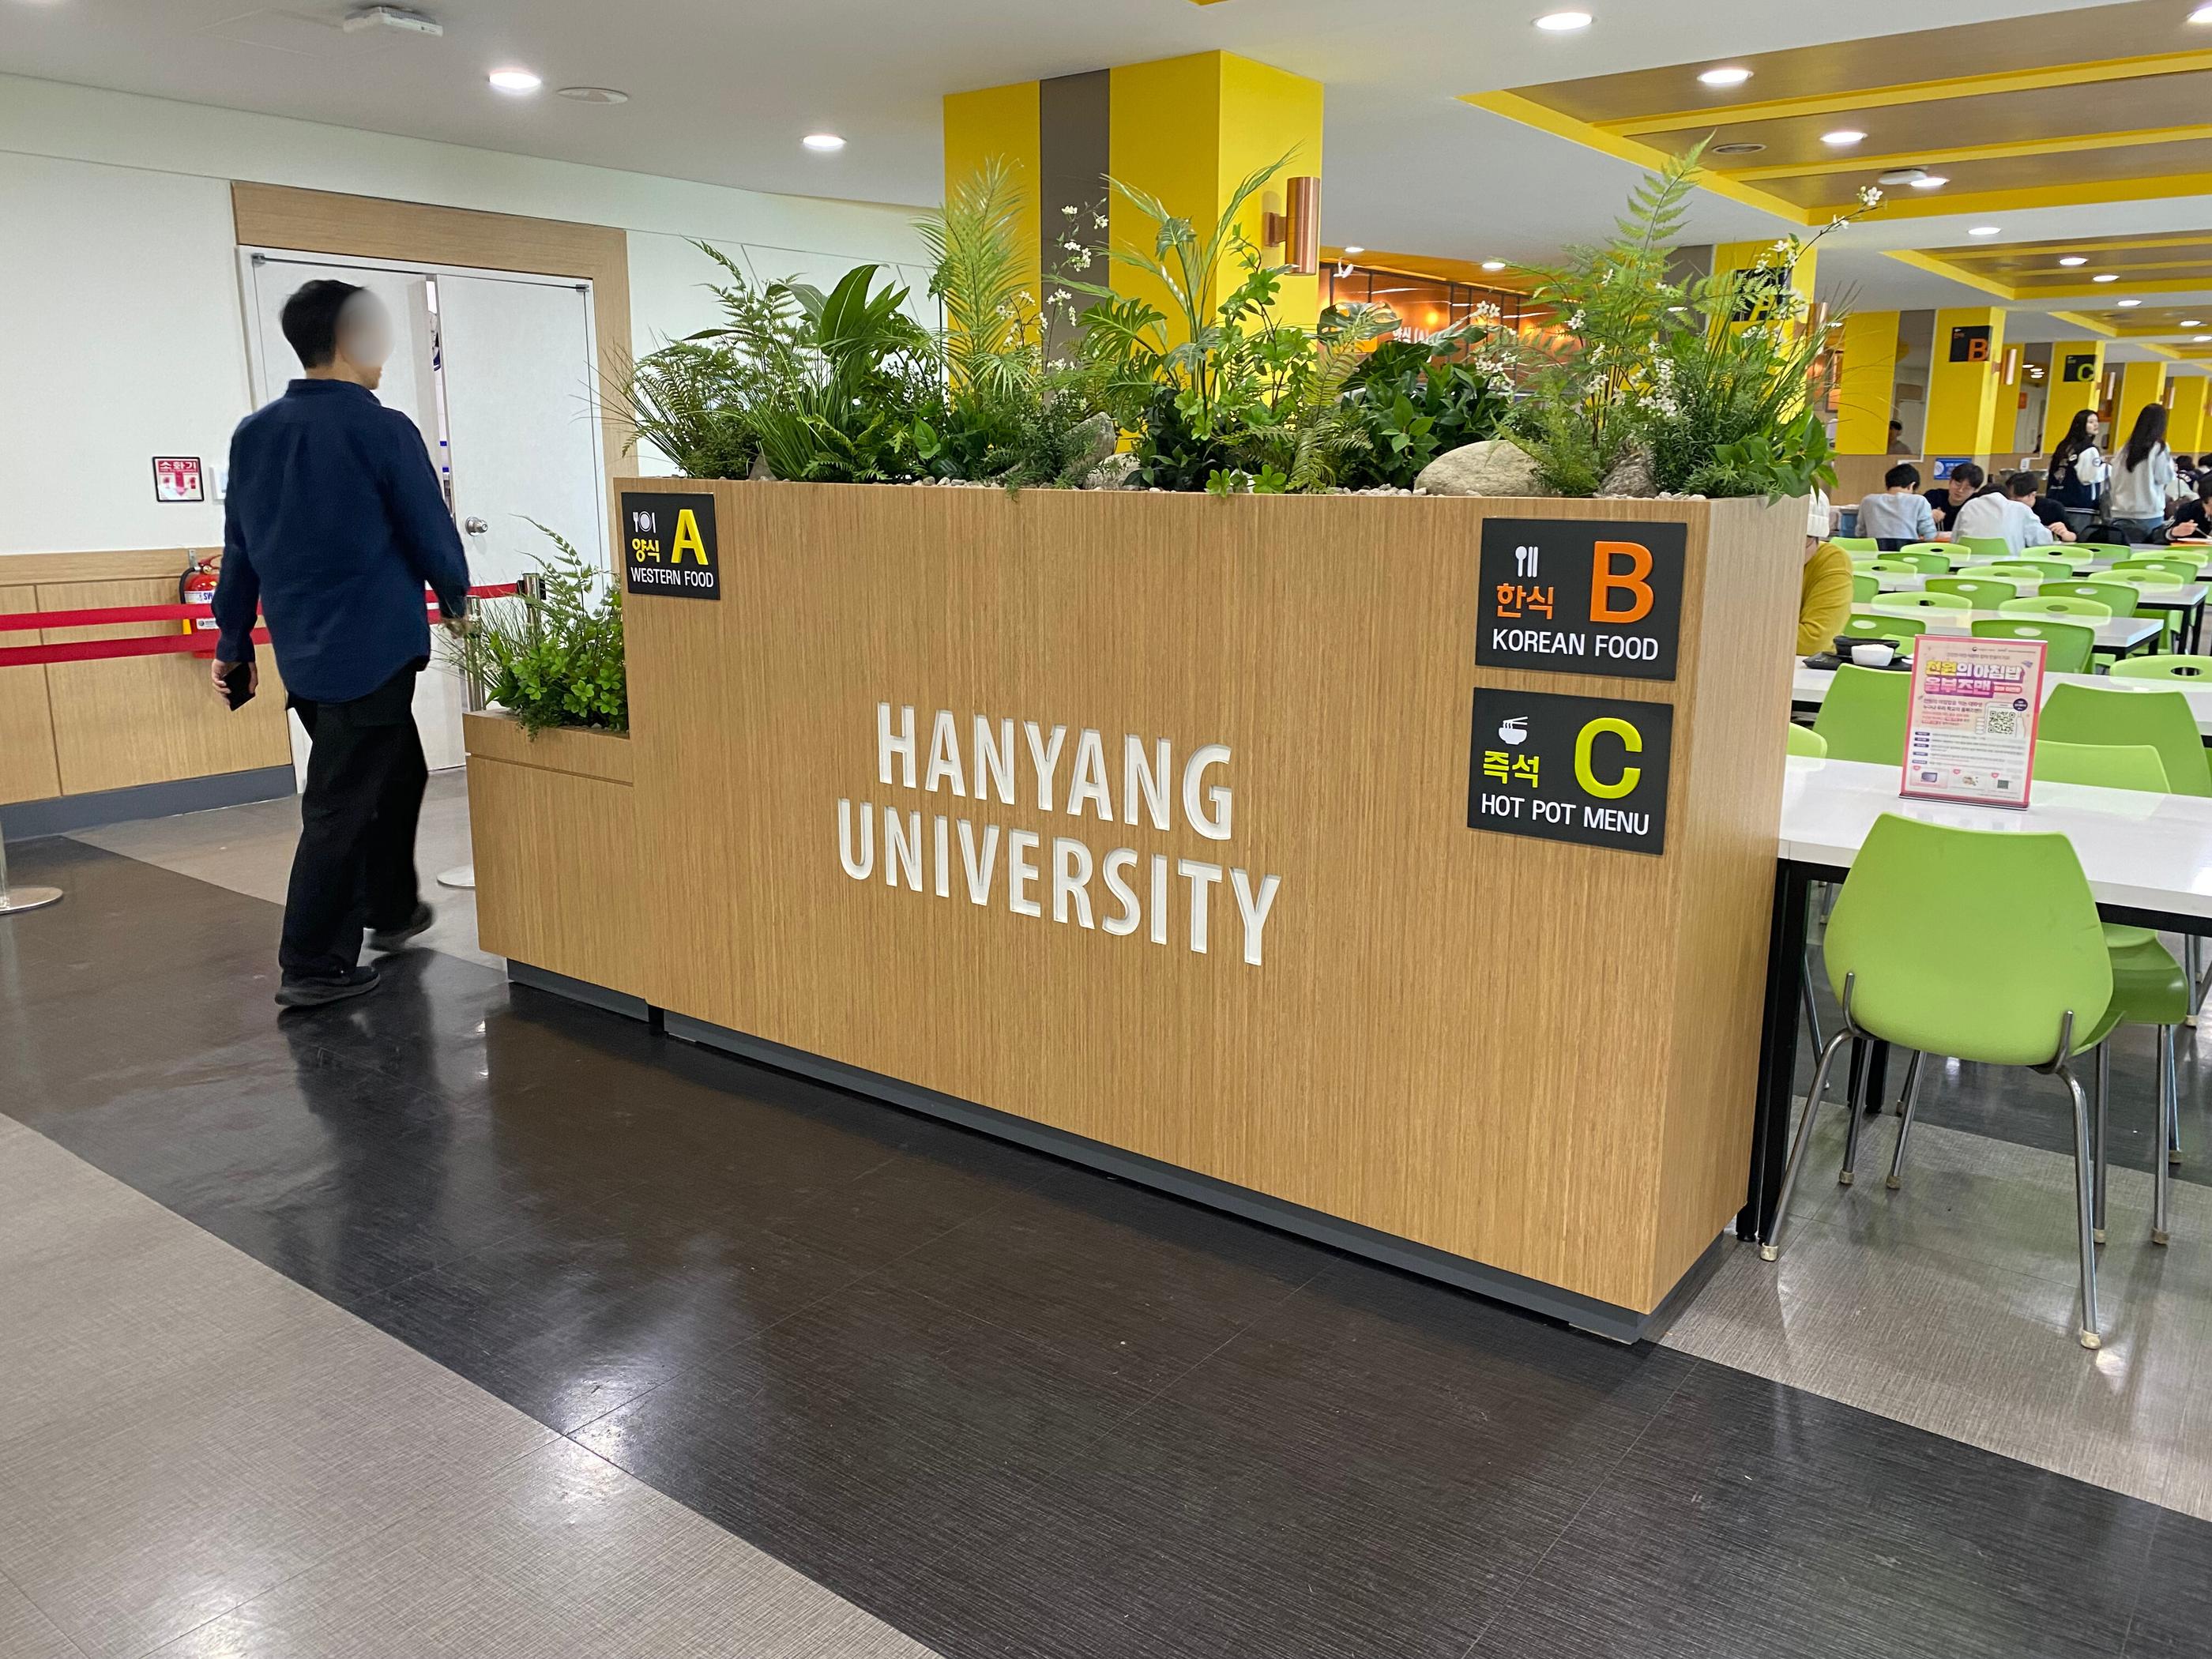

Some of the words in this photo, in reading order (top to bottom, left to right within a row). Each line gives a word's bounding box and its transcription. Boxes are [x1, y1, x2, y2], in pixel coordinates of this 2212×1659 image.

[1968, 338, 1988, 362] B
[2077, 363, 2094, 382] C
[632, 538, 660, 562] 양식
[671, 509, 709, 566] A
[630, 566, 681, 585] WESTERN
[684, 570, 714, 588] FOOD
[1589, 540, 1654, 624] B
[1496, 582, 1555, 620] 한식
[1492, 628, 1586, 656] KOREAN
[1594, 634, 1659, 661] FOOD
[1973, 663, 2023, 681] 아침밥
[877, 701, 1232, 841] HANYANG
[1482, 750, 1540, 788] 즉석
[1574, 717, 1642, 799] C
[1480, 792, 1525, 818] HOT
[1531, 799, 1576, 826] POT
[1582, 806, 1650, 837] MENU
[837, 797, 1281, 966] UNIVERSITY
